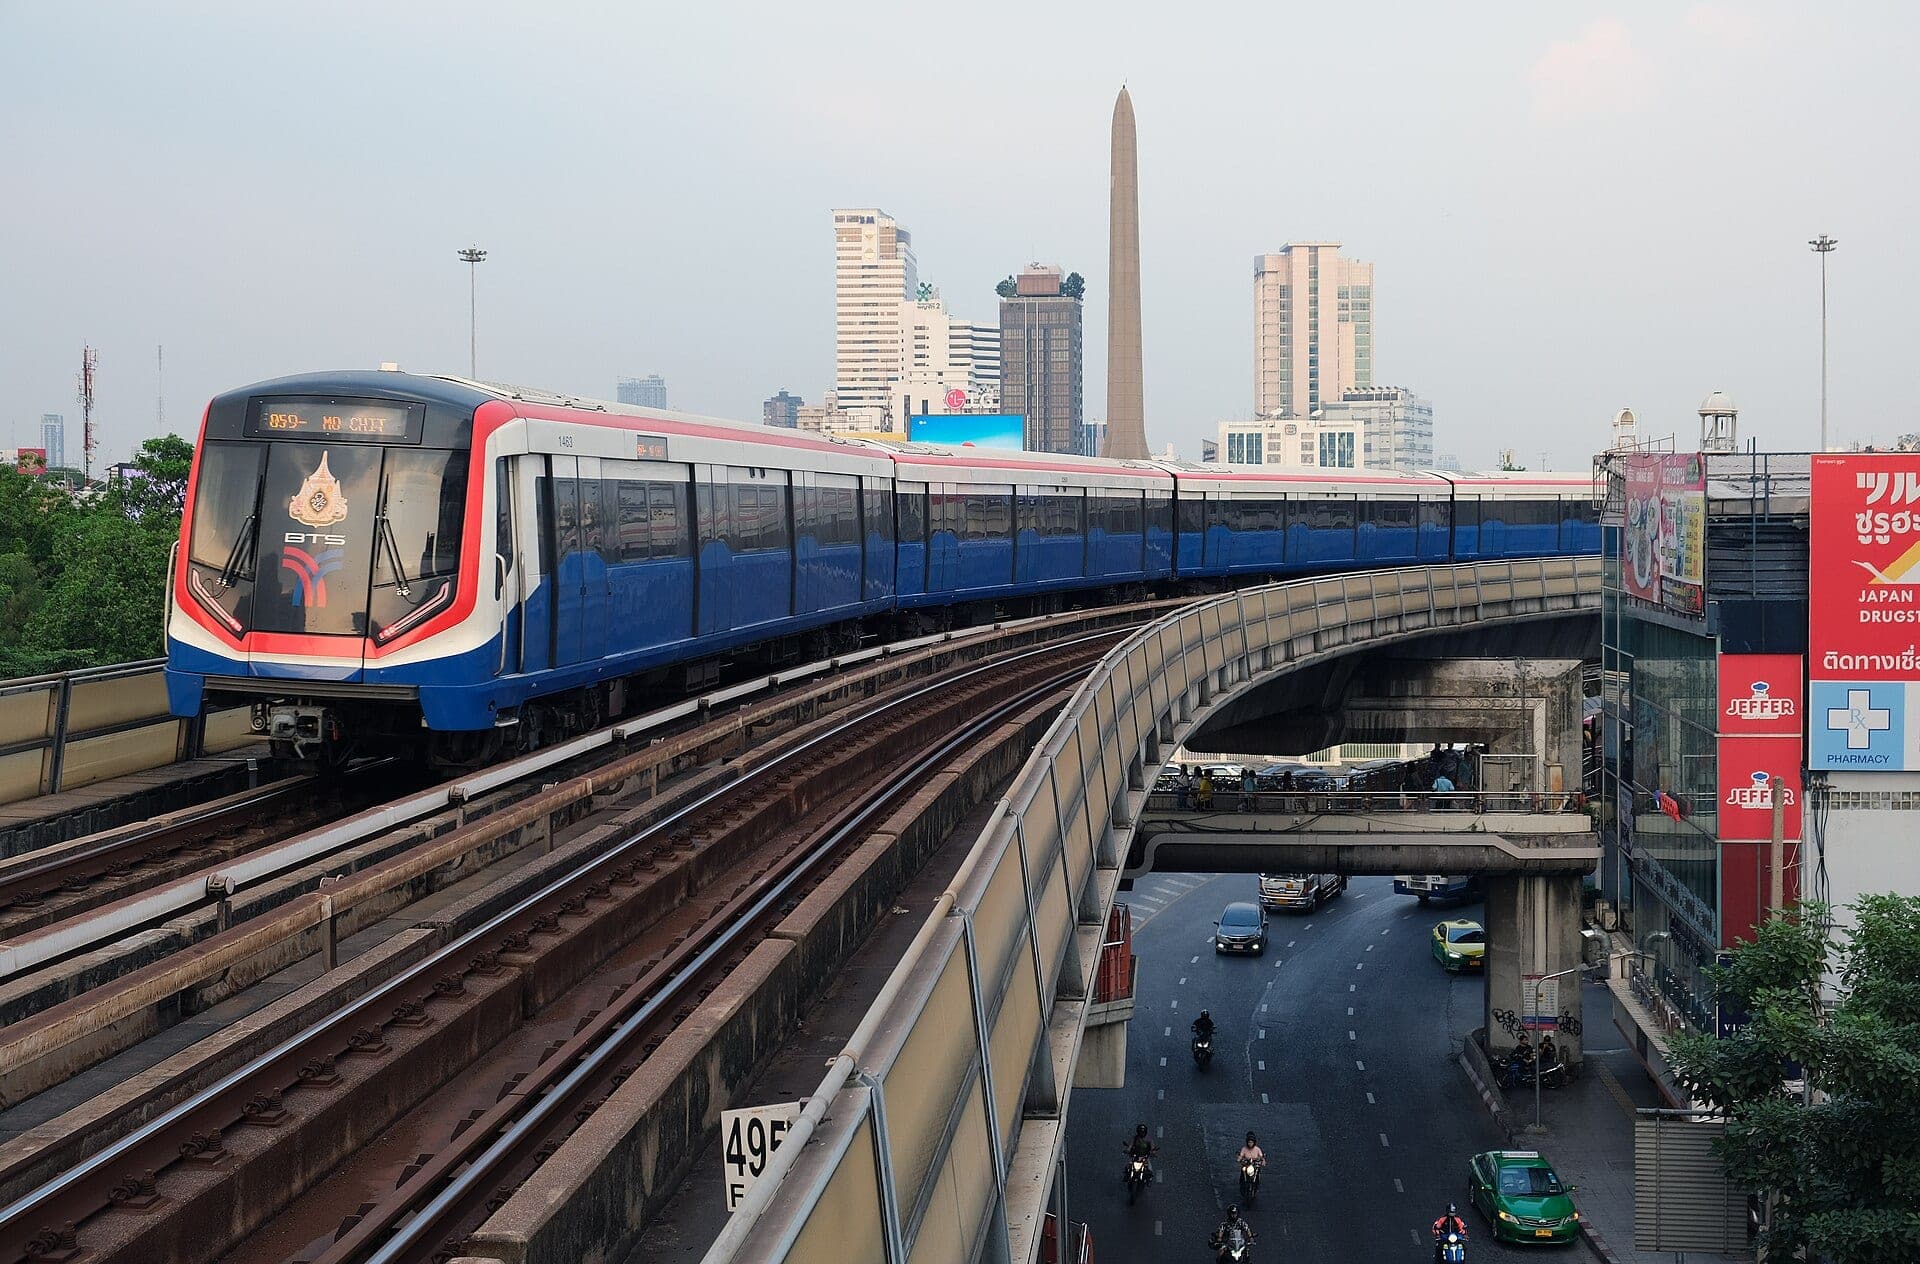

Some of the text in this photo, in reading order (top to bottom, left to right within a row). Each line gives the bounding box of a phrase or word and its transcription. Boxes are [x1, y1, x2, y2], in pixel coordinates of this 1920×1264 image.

[349, 417, 388, 432] CHIT
[284, 532, 346, 546] BTS
[1858, 589, 1913, 603] JAPAN
[1728, 700, 1792, 714] JEFFER
[1827, 754, 1890, 764] PHARMACY
[1728, 790, 1792, 803] JEFFR
